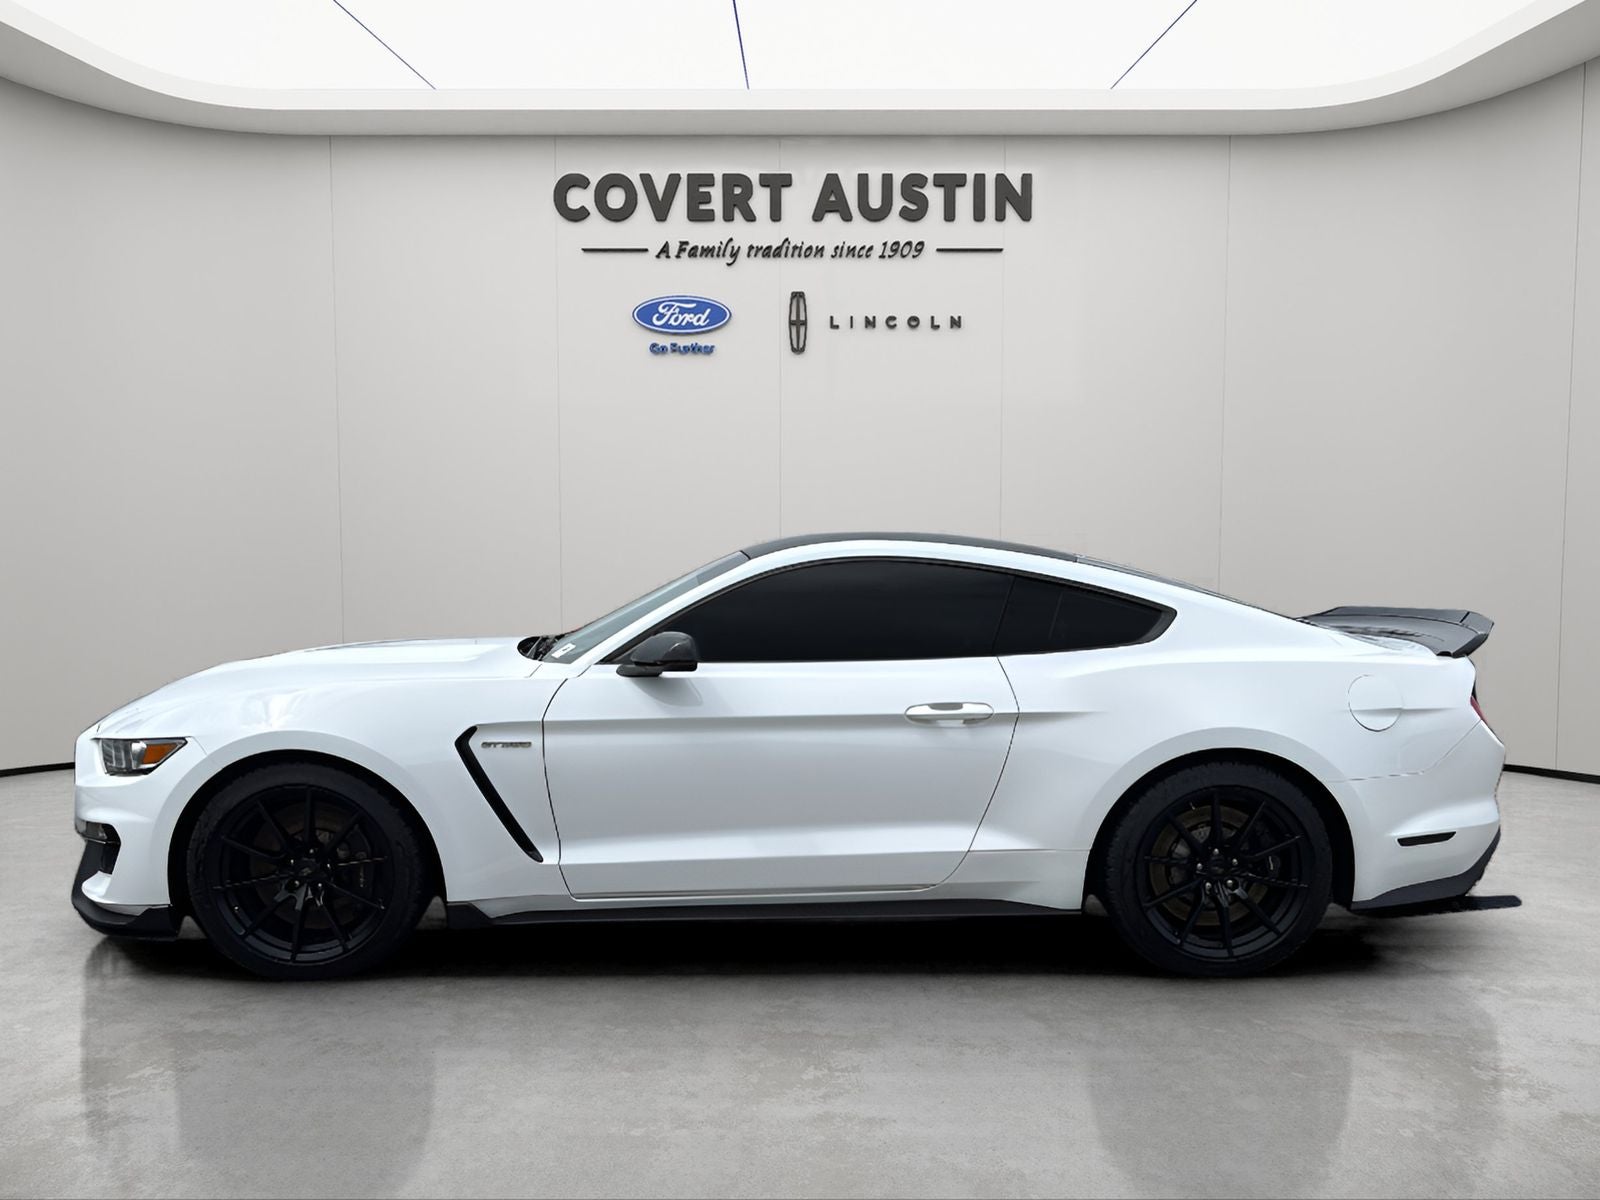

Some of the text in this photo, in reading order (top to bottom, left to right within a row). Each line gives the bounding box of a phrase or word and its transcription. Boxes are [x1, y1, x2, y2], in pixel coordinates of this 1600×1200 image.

[553, 172, 1033, 223] COVERT AUSTIN
[655, 237, 925, 267] A Family tradition since 1909
[652, 301, 711, 326] Ford
[829, 315, 962, 330] LINCOLN
